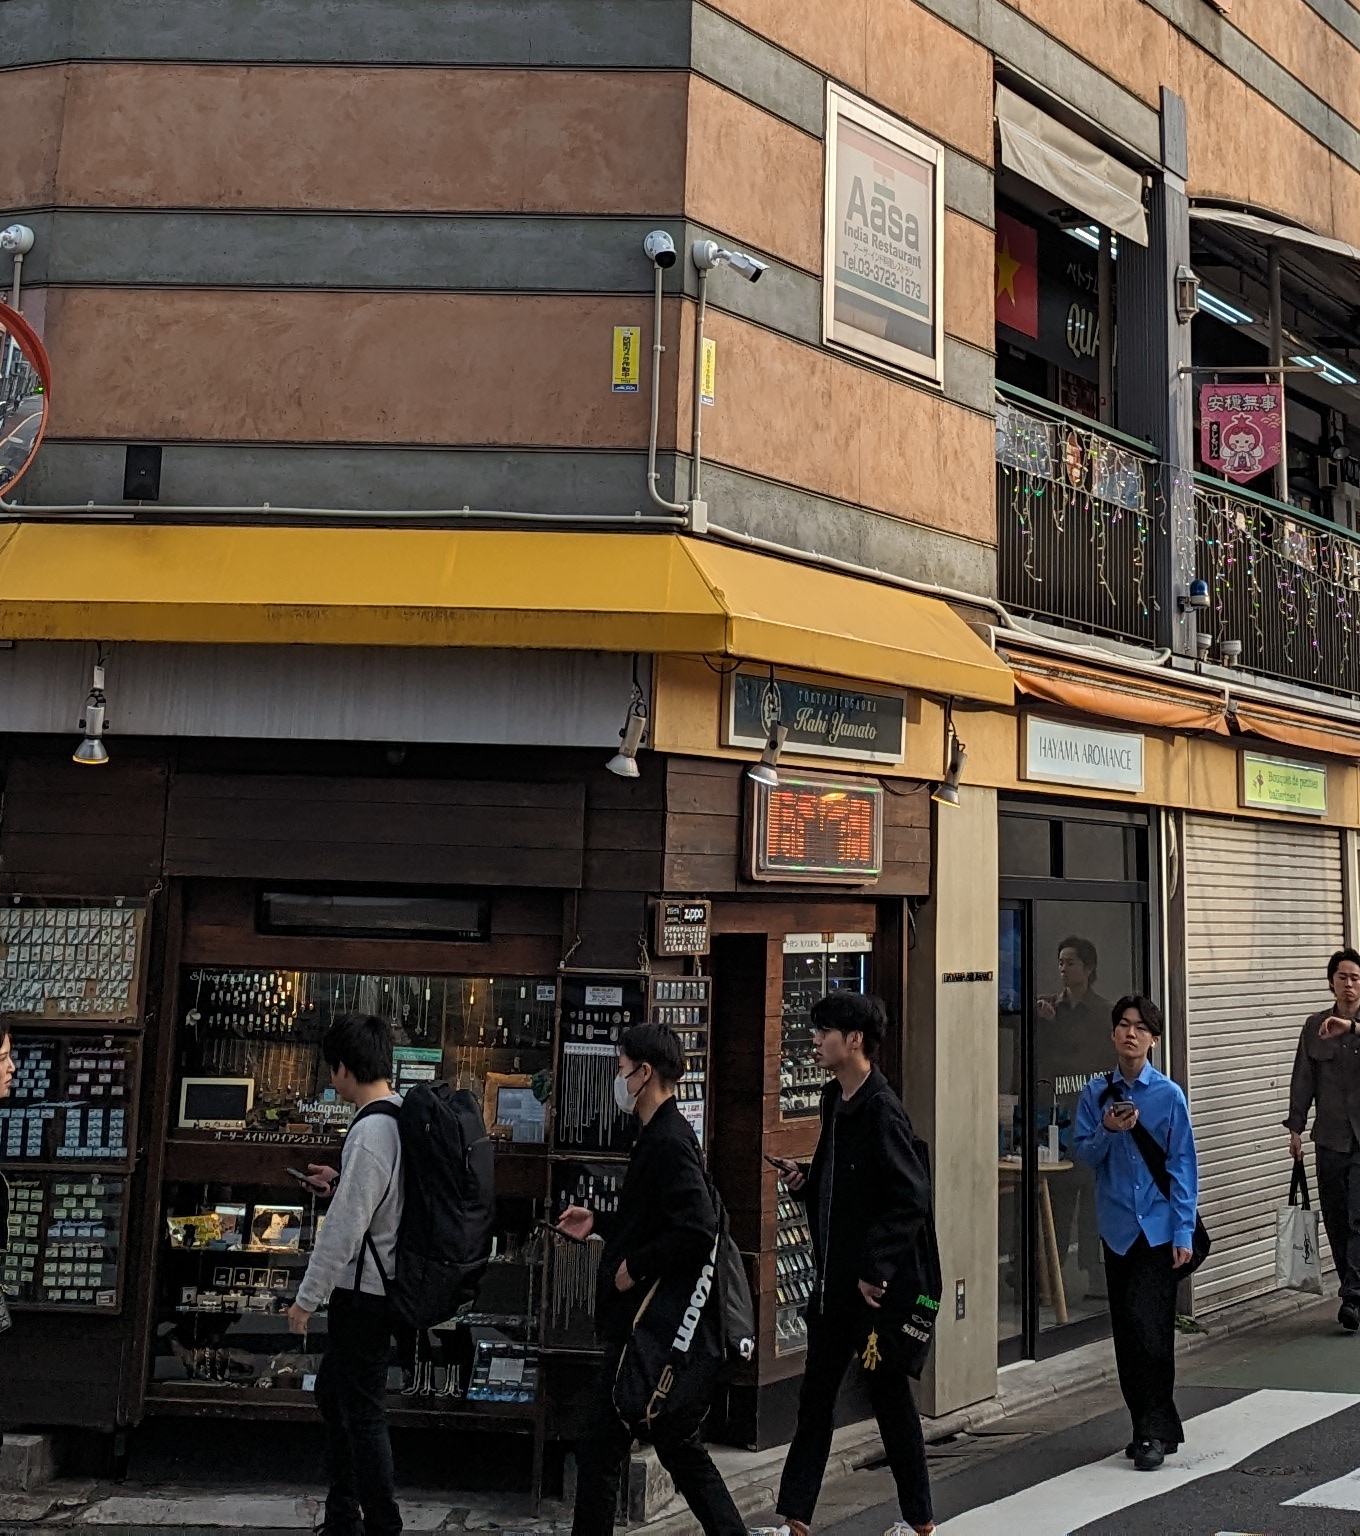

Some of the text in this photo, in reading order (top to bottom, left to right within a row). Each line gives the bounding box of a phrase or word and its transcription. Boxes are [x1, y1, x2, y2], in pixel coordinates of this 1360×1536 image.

[843, 221, 922, 269] India Restaurant
[793, 707, 877, 744] Kahi Yamato
[1040, 736, 1132, 771] HAYAMA AROMANCE
[1055, 1074, 1087, 1095] HAYAMA
[296, 1099, 352, 1118] Instagram
[214, 1131, 338, 1144] オーダーメイドハワイアンジュエリー
